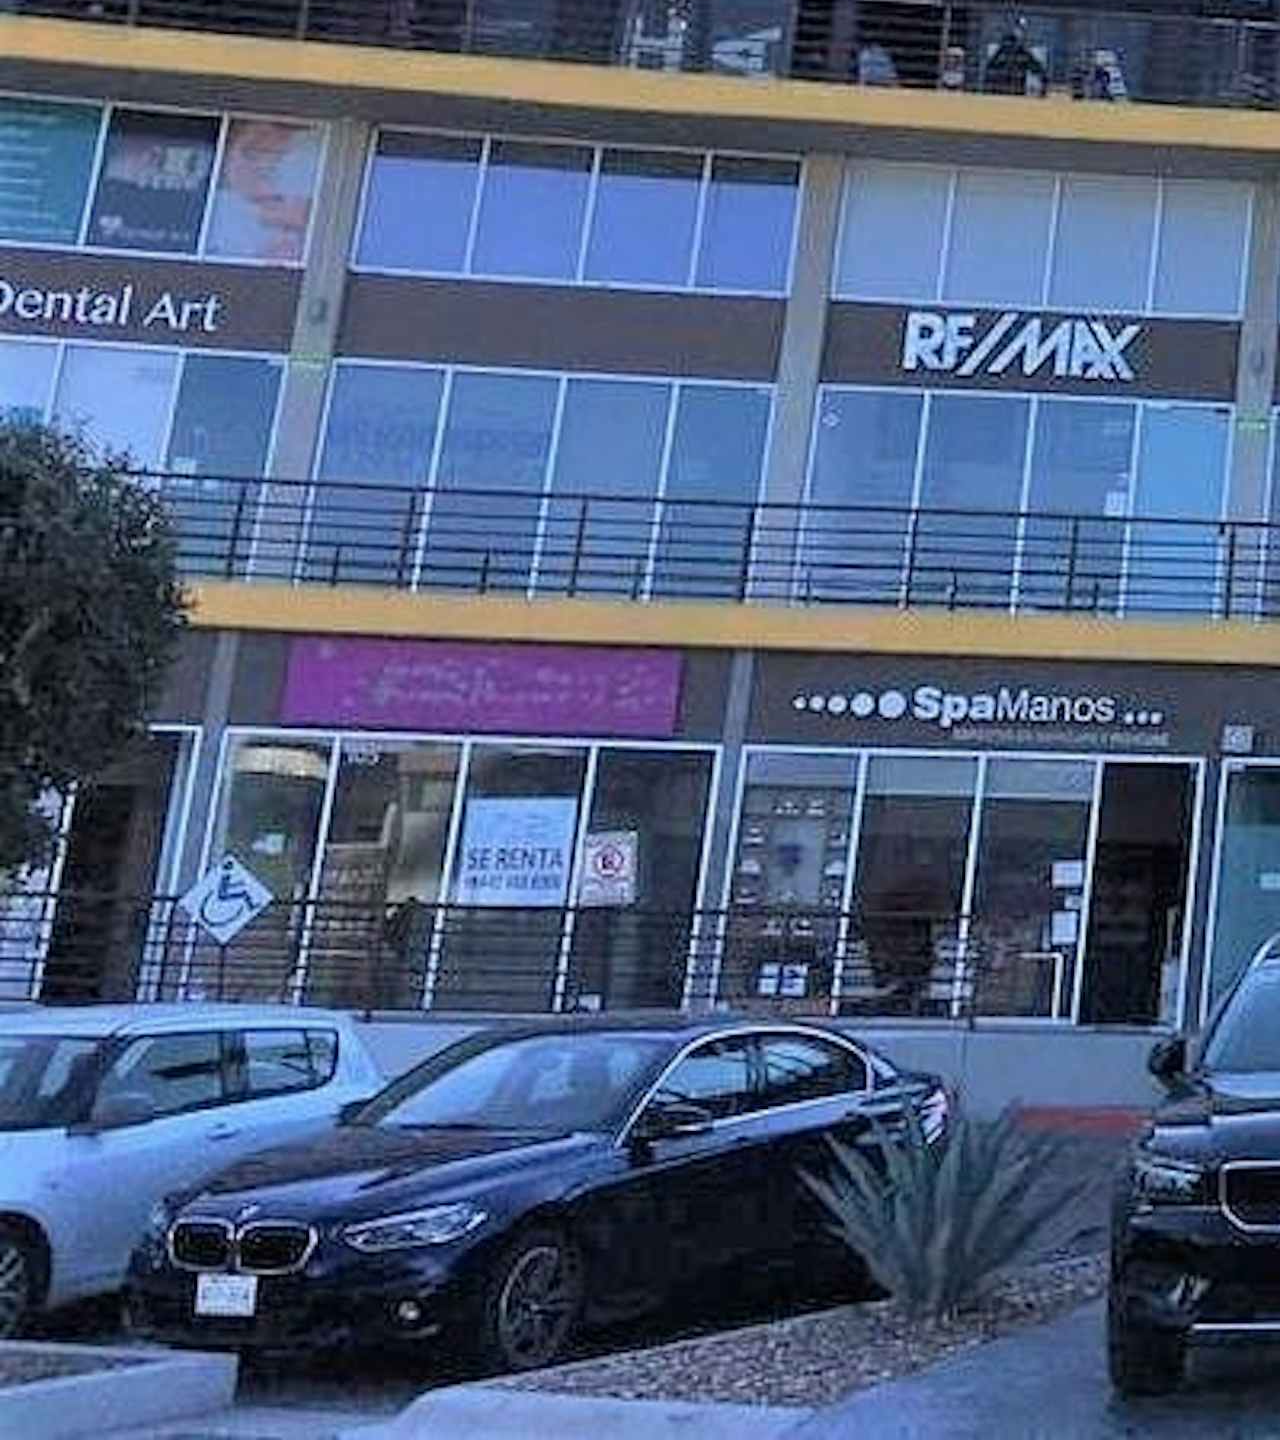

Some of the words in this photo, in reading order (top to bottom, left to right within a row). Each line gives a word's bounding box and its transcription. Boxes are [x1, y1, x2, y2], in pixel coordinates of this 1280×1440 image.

[143, 292, 222, 332] Art
[902, 312, 1142, 380] RE/MAX
[467, 847, 492, 870] SE
[495, 847, 564, 871] RENTA
